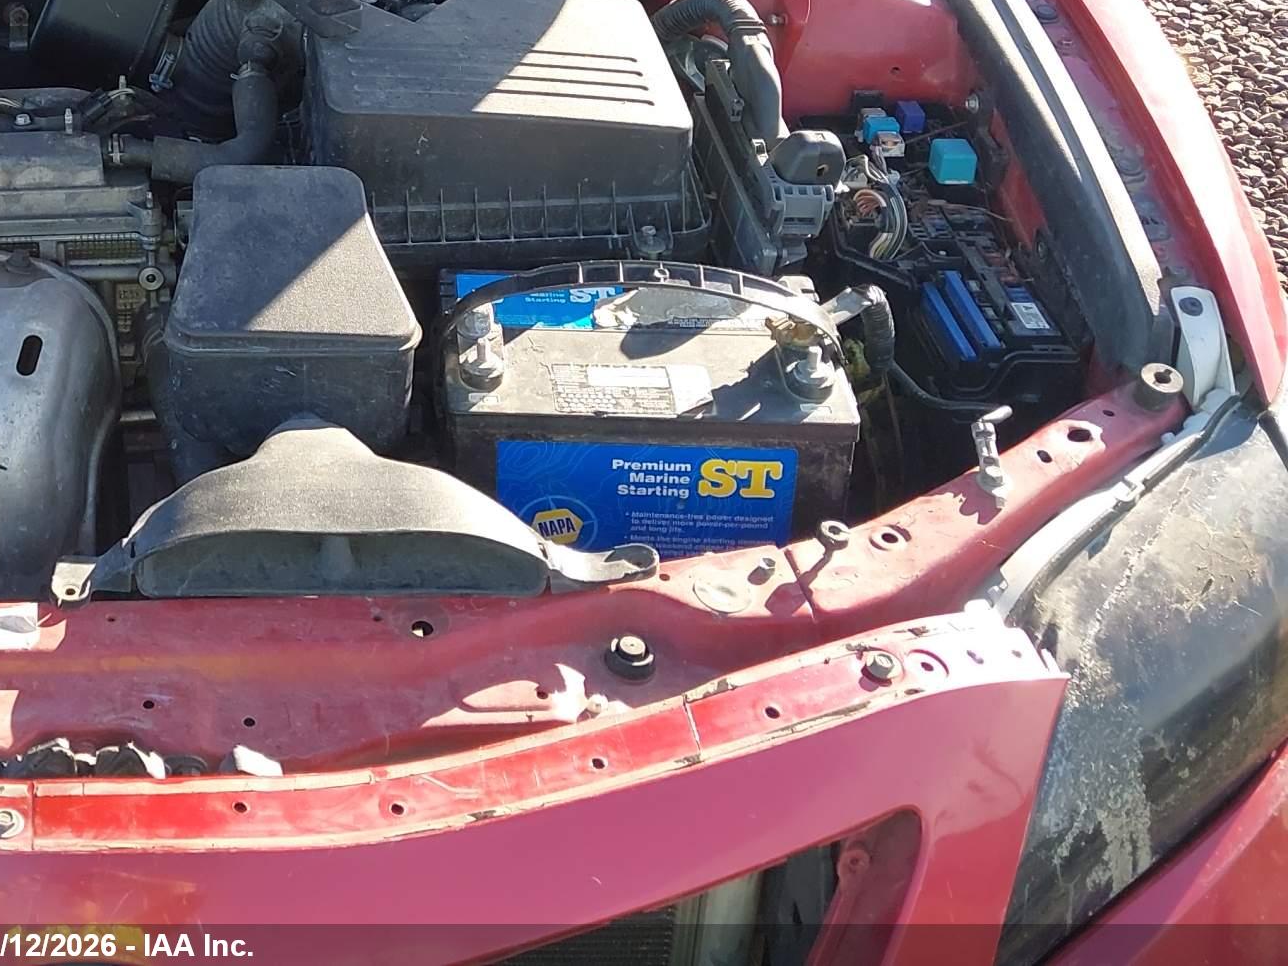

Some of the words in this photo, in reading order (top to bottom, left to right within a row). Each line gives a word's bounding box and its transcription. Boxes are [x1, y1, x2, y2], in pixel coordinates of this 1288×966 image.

[569, 288, 616, 303] ST
[612, 459, 692, 472] Premium
[629, 472, 691, 484] Marine
[698, 459, 783, 498] ST
[617, 484, 690, 499] Starting
[537, 517, 576, 537] NAPA
[733, 515, 774, 524] designed
